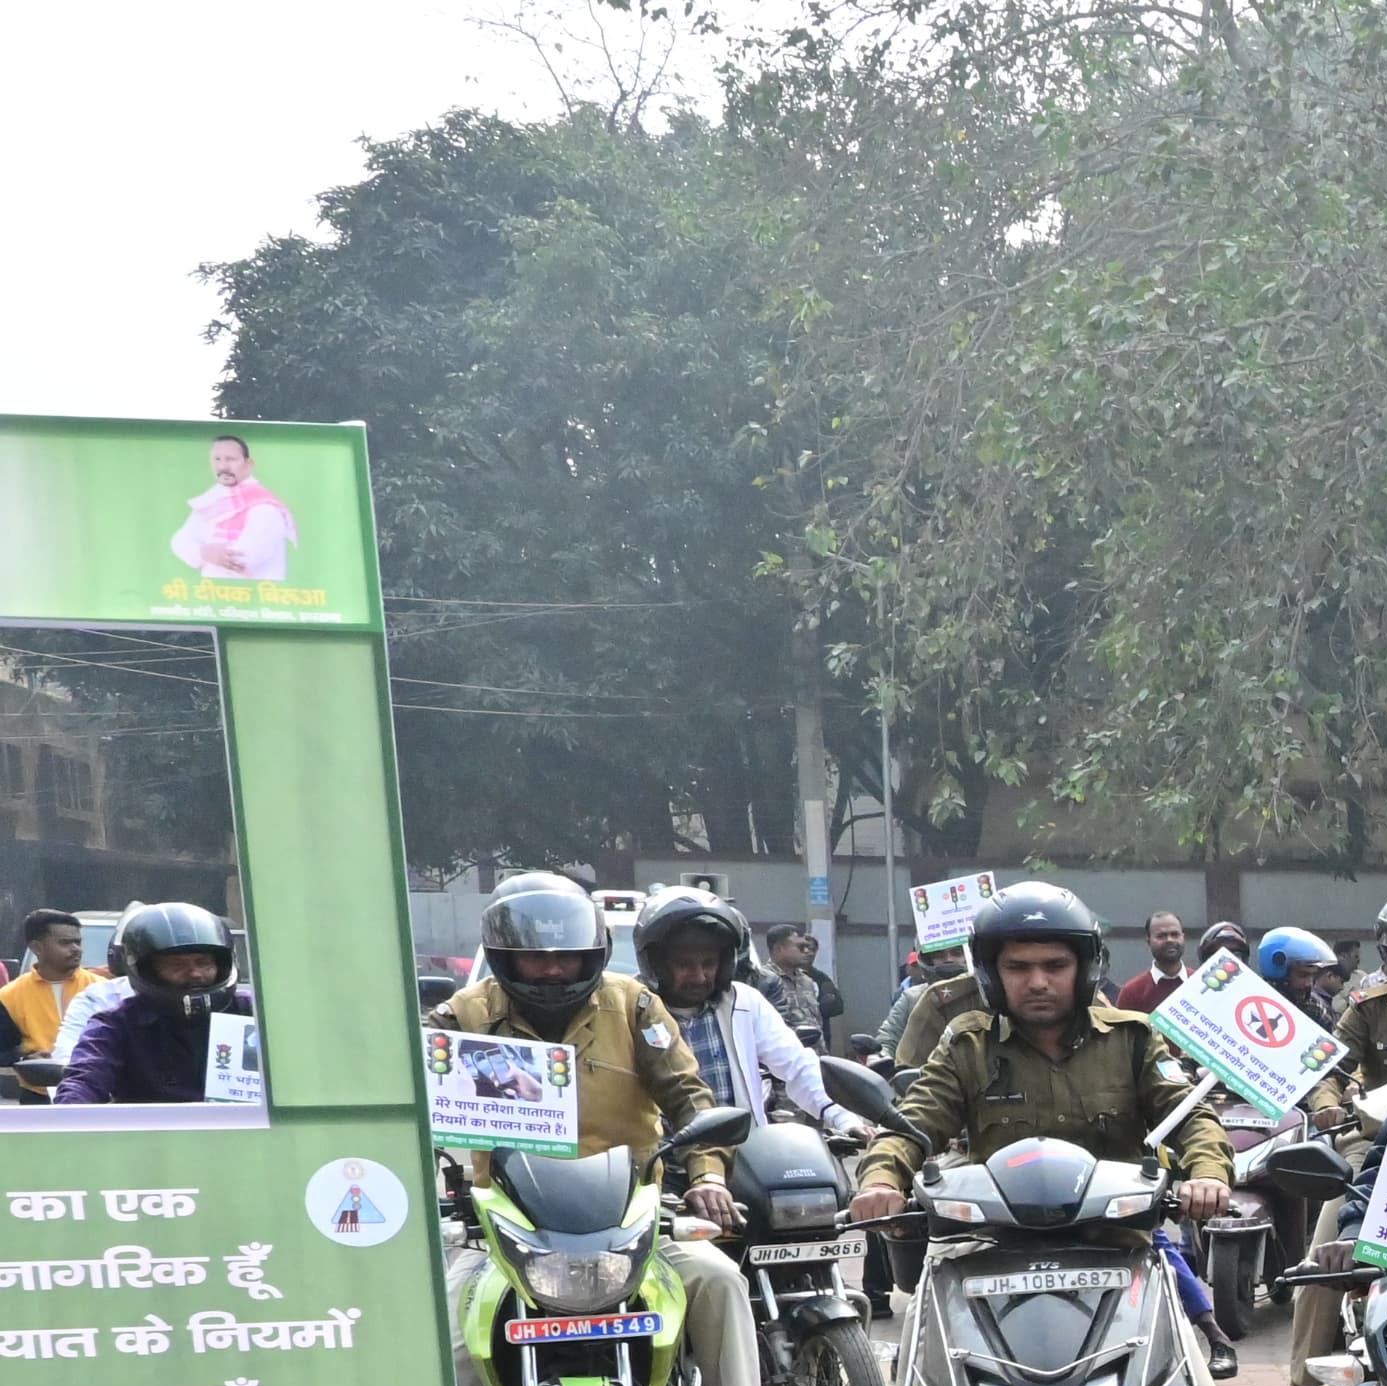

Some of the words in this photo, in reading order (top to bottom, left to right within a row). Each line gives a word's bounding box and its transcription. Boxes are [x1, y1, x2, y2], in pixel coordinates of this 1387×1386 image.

[435, 1096, 450, 1110] मेरे
[455, 1101, 479, 1112] पापा
[483, 1100, 514, 1115] हमेशा
[518, 1106, 565, 1120] यातायात
[470, 1117, 486, 1128] का
[490, 1119, 521, 1131] पालन
[525, 1121, 550, 1135] करते
[6, 1190, 88, 1222] का
[100, 1188, 199, 1222] एक
[223, 1241, 284, 1300] हूँ
[1028, 1261, 1060, 1270] TVS
[111, 1314, 173, 1355] के
[187, 1307, 361, 1353] नियमों
[514, 1324, 536, 1340] JH
[541, 1322, 560, 1337] 10
[566, 1320, 591, 1335] AM
[598, 1316, 655, 1334] 1549
